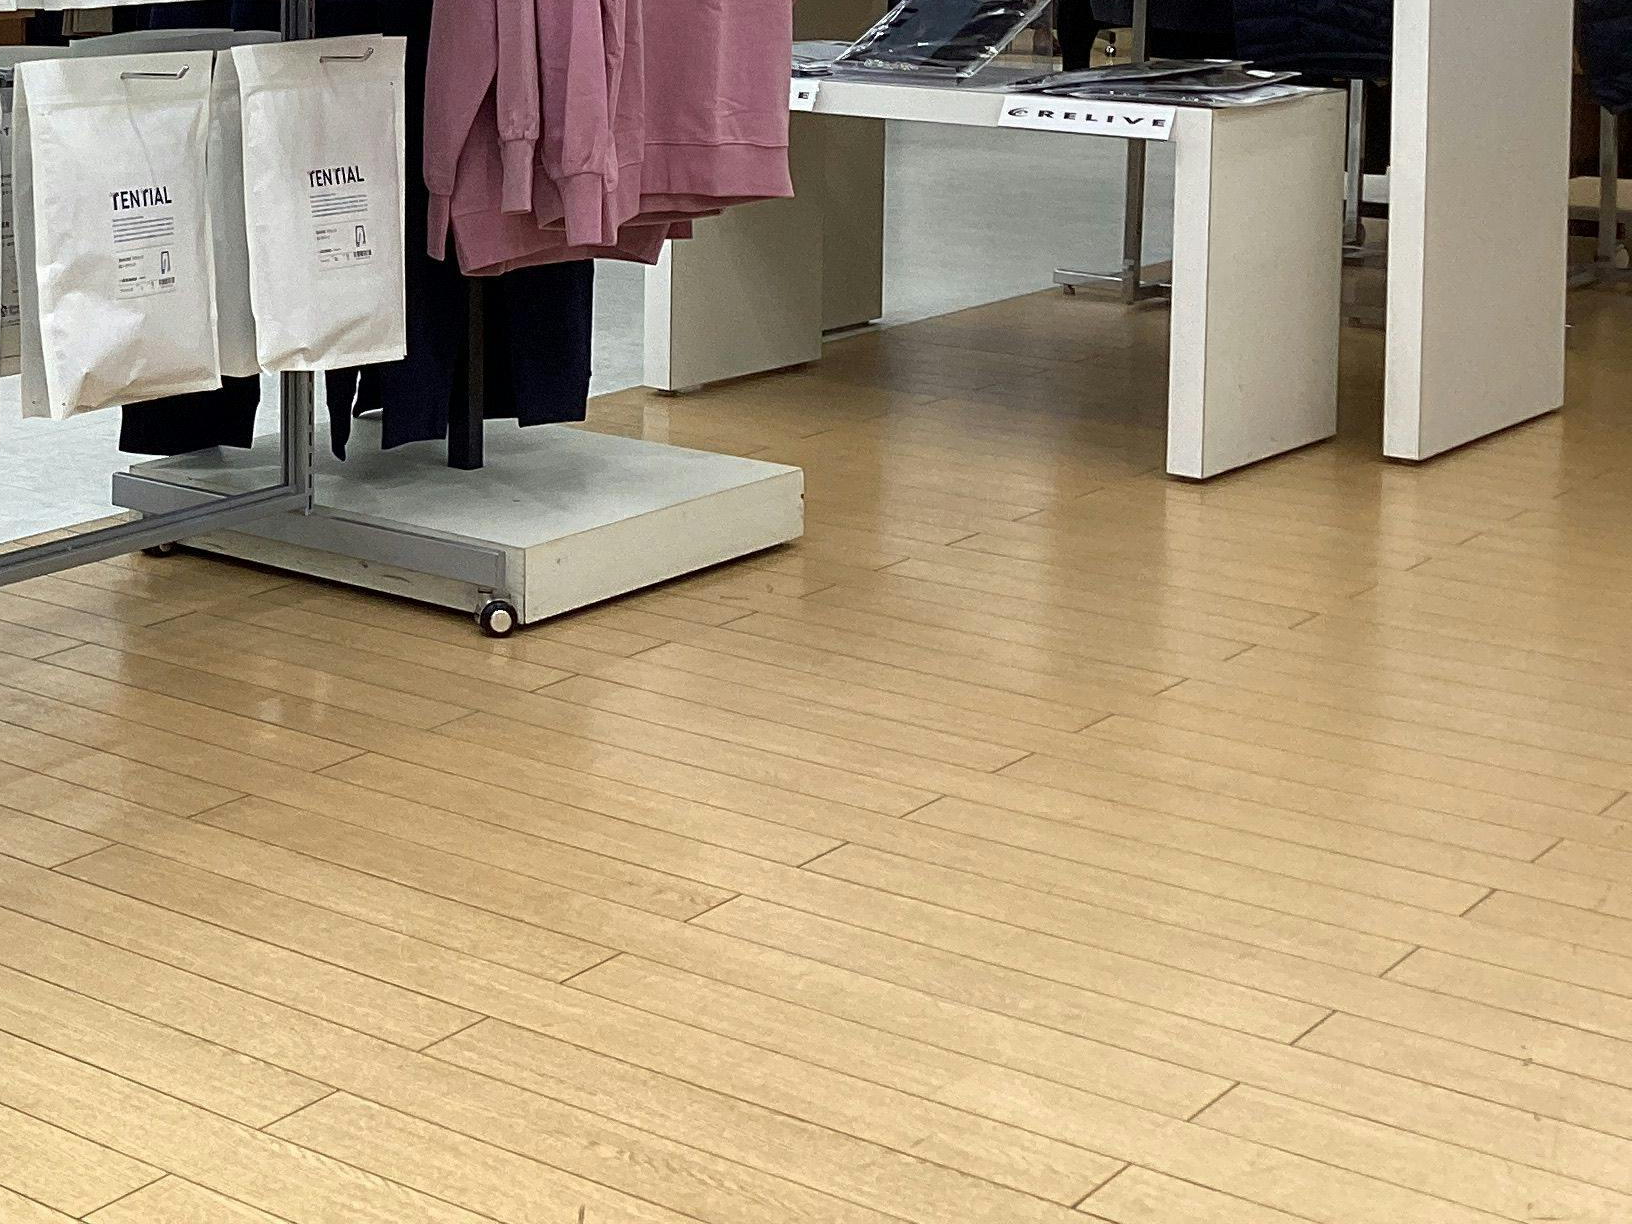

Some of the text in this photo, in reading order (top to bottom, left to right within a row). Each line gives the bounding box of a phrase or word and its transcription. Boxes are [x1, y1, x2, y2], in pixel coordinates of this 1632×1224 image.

[1037, 109, 1166, 127] RELIVE
[308, 165, 365, 187] TENTIAL
[110, 186, 172, 210] TENTIAL
